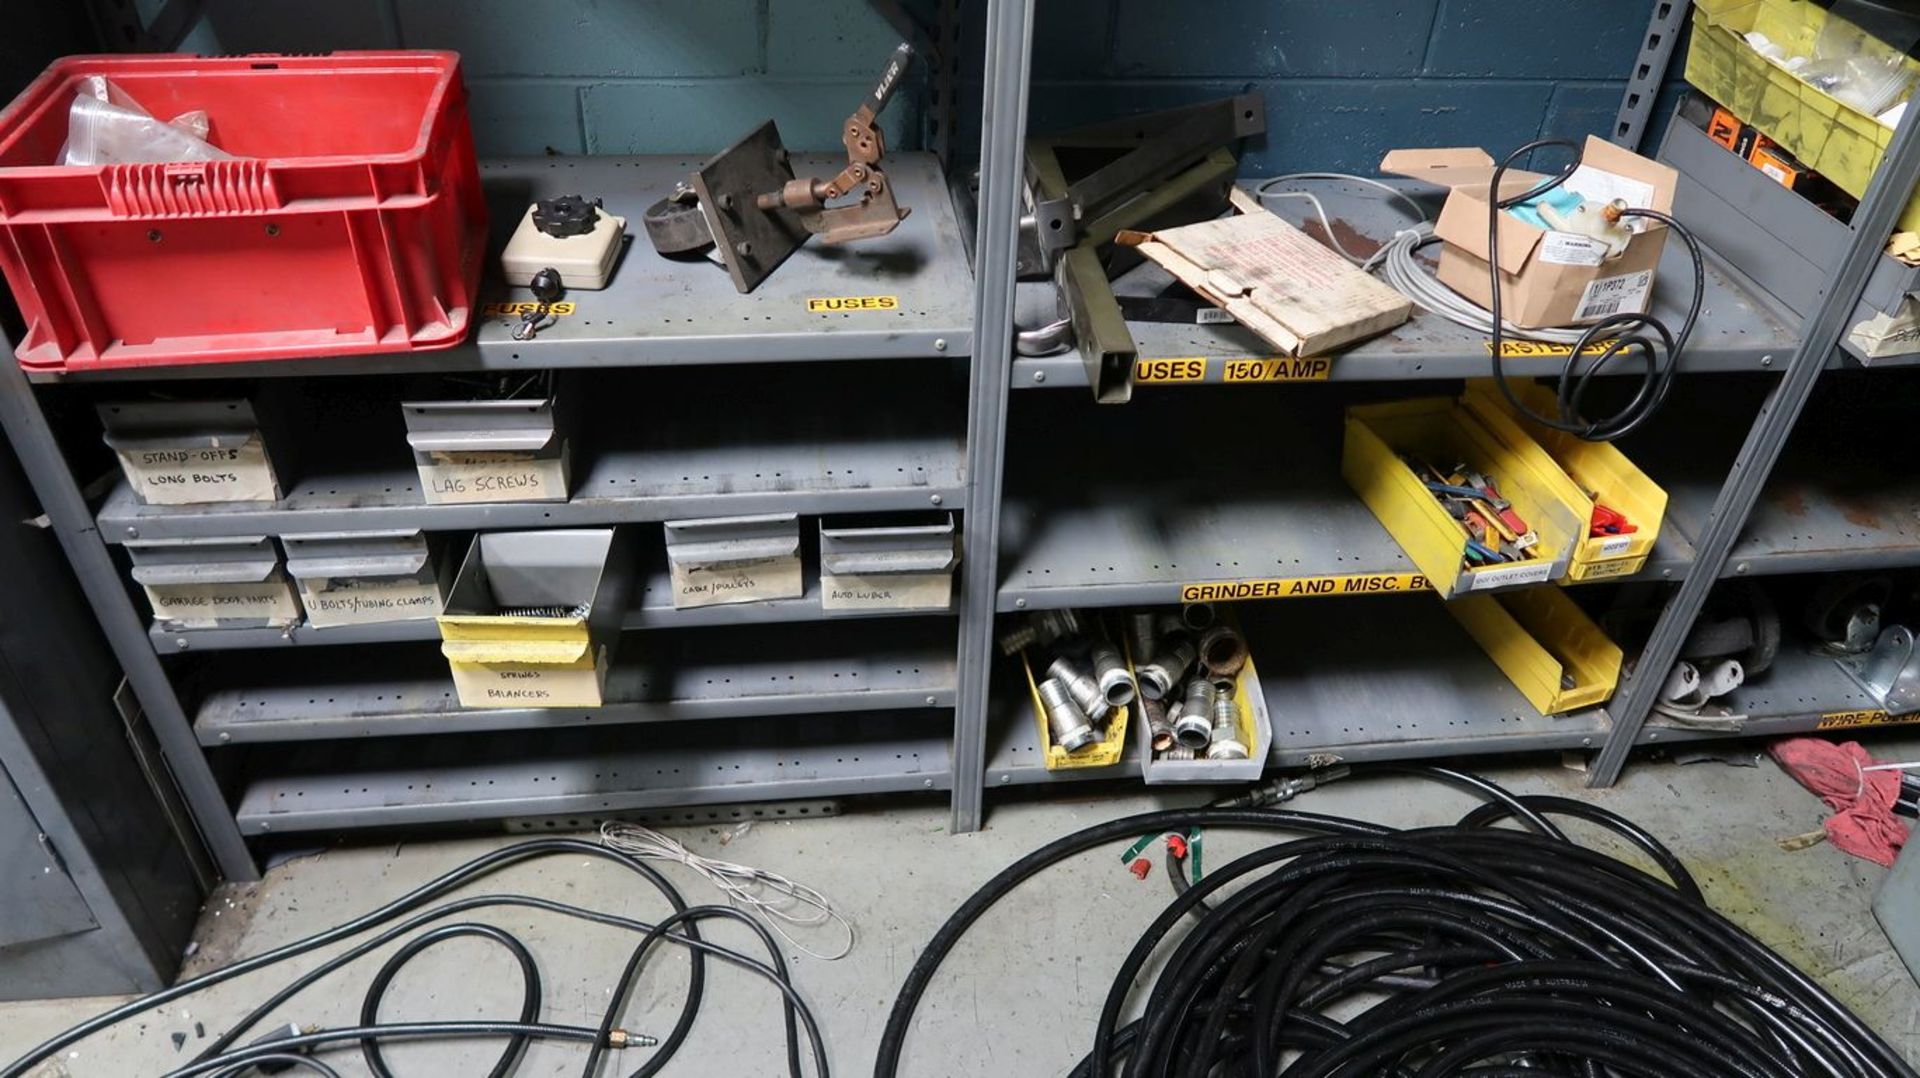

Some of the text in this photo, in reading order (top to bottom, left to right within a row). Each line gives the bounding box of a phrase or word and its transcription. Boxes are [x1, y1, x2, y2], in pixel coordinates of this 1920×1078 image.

[875, 60, 899, 100] VLIER
[809, 297, 895, 311] FUSES
[1226, 360, 1328, 380] 150/AMP
[147, 473, 238, 486] LONG BOLTS
[432, 474, 539, 493] LAG SCREWS
[1183, 582, 1281, 600] GRINDER
[1289, 579, 1336, 595] AND
[1343, 576, 1401, 592] MISC.
[160, 597, 209, 607] GARAGE
[308, 600, 317, 610] U
[396, 596, 434, 607] CLAMPS
[500, 671, 540, 680] SPRINGS
[487, 688, 550, 698] BALANCERS
[1822, 712, 1866, 727] WIRE
